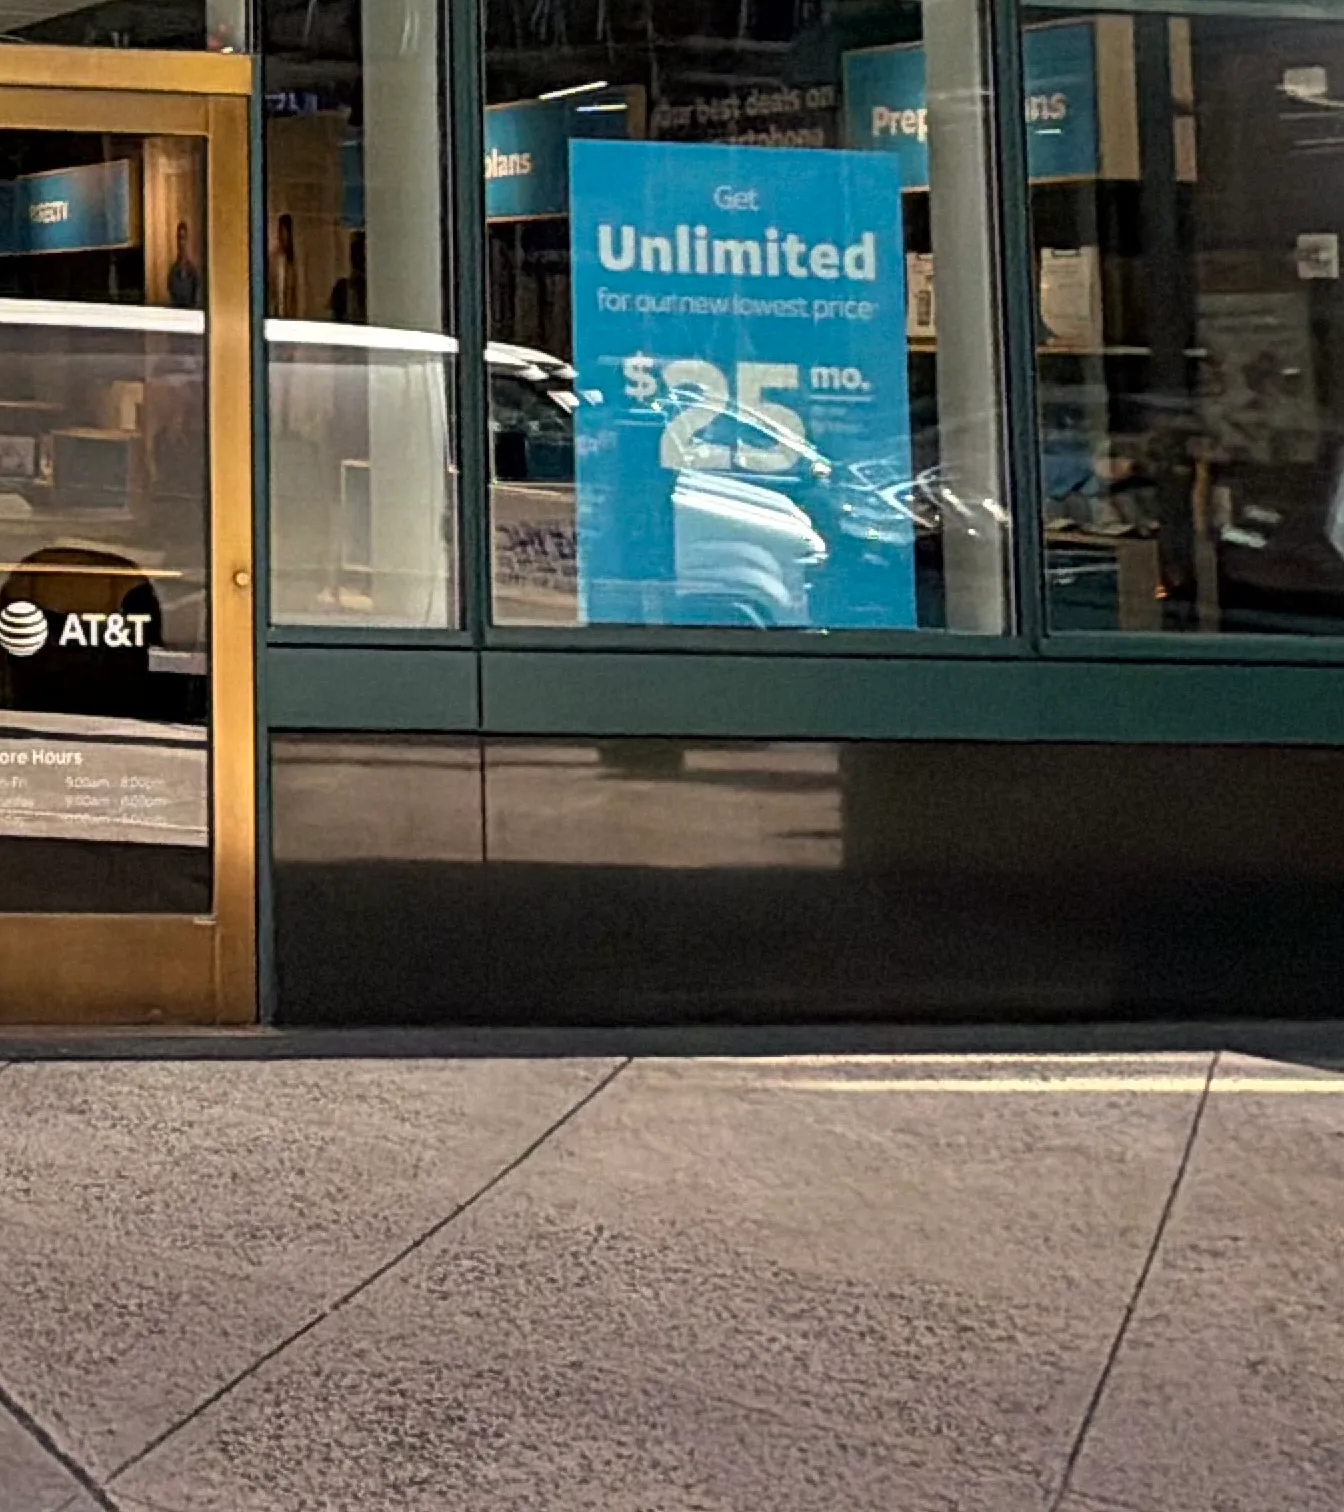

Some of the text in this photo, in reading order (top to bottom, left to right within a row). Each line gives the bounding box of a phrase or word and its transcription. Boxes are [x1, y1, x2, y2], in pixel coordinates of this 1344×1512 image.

[713, 184, 760, 212] Get
[597, 223, 877, 282] Unlimited
[596, 287, 628, 312] for
[677, 296, 728, 316] new
[810, 365, 871, 390] mo.
[58, 612, 152, 648] AT&T
[31, 748, 84, 766] Hours
